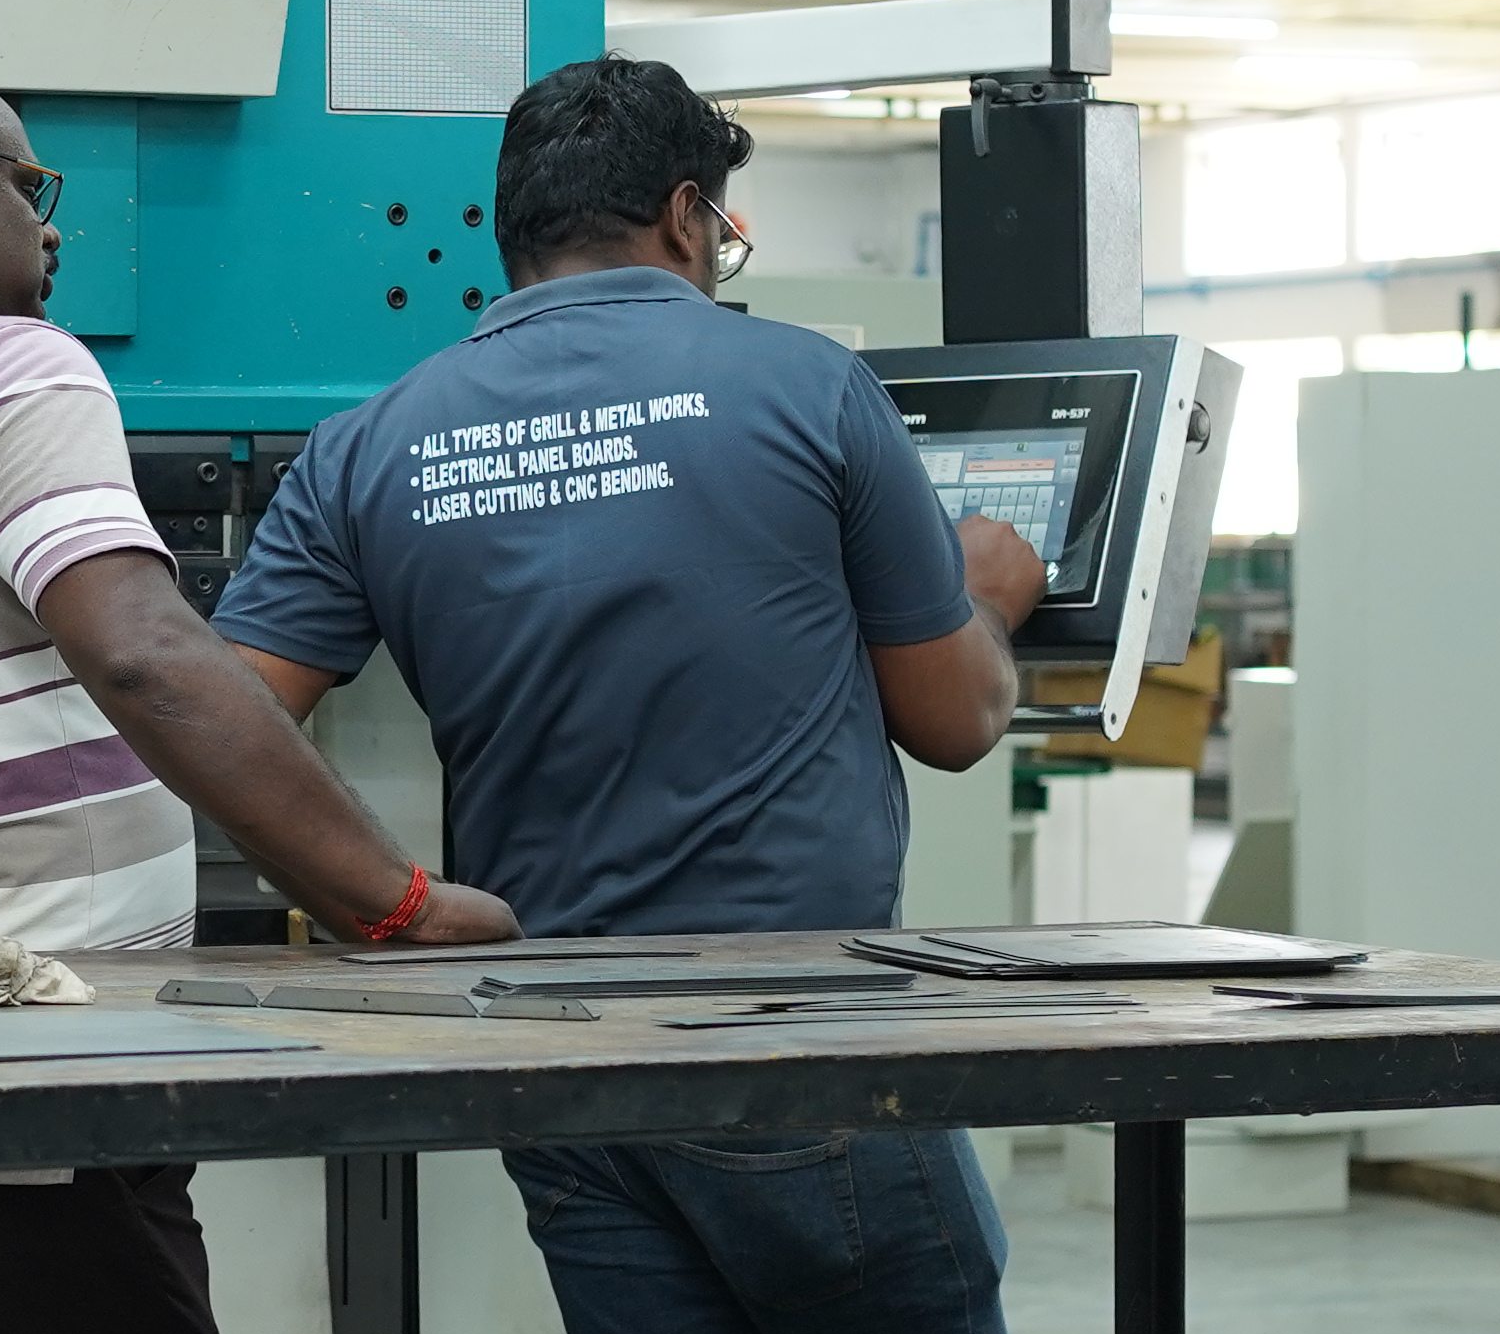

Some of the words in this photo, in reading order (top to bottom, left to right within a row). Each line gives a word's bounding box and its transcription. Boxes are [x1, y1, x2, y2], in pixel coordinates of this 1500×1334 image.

[421, 435, 450, 460] ALL
[452, 422, 502, 454] TYPES
[505, 419, 527, 446] OF
[530, 411, 576, 443] GRILL
[579, 409, 592, 434] &
[595, 403, 646, 433] METAL
[648, 392, 710, 423] WORKS.
[1051, 407, 1092, 420] DA-53T
[421, 453, 516, 492] ELECTRICAL
[518, 445, 569, 477] PANEL
[571, 435, 638, 466] BOARDS.
[423, 492, 472, 527] LASER
[474, 482, 546, 517] CUTTING
[549, 479, 562, 506] &
[564, 474, 598, 503] CNC
[600, 461, 674, 498] BENDING.
